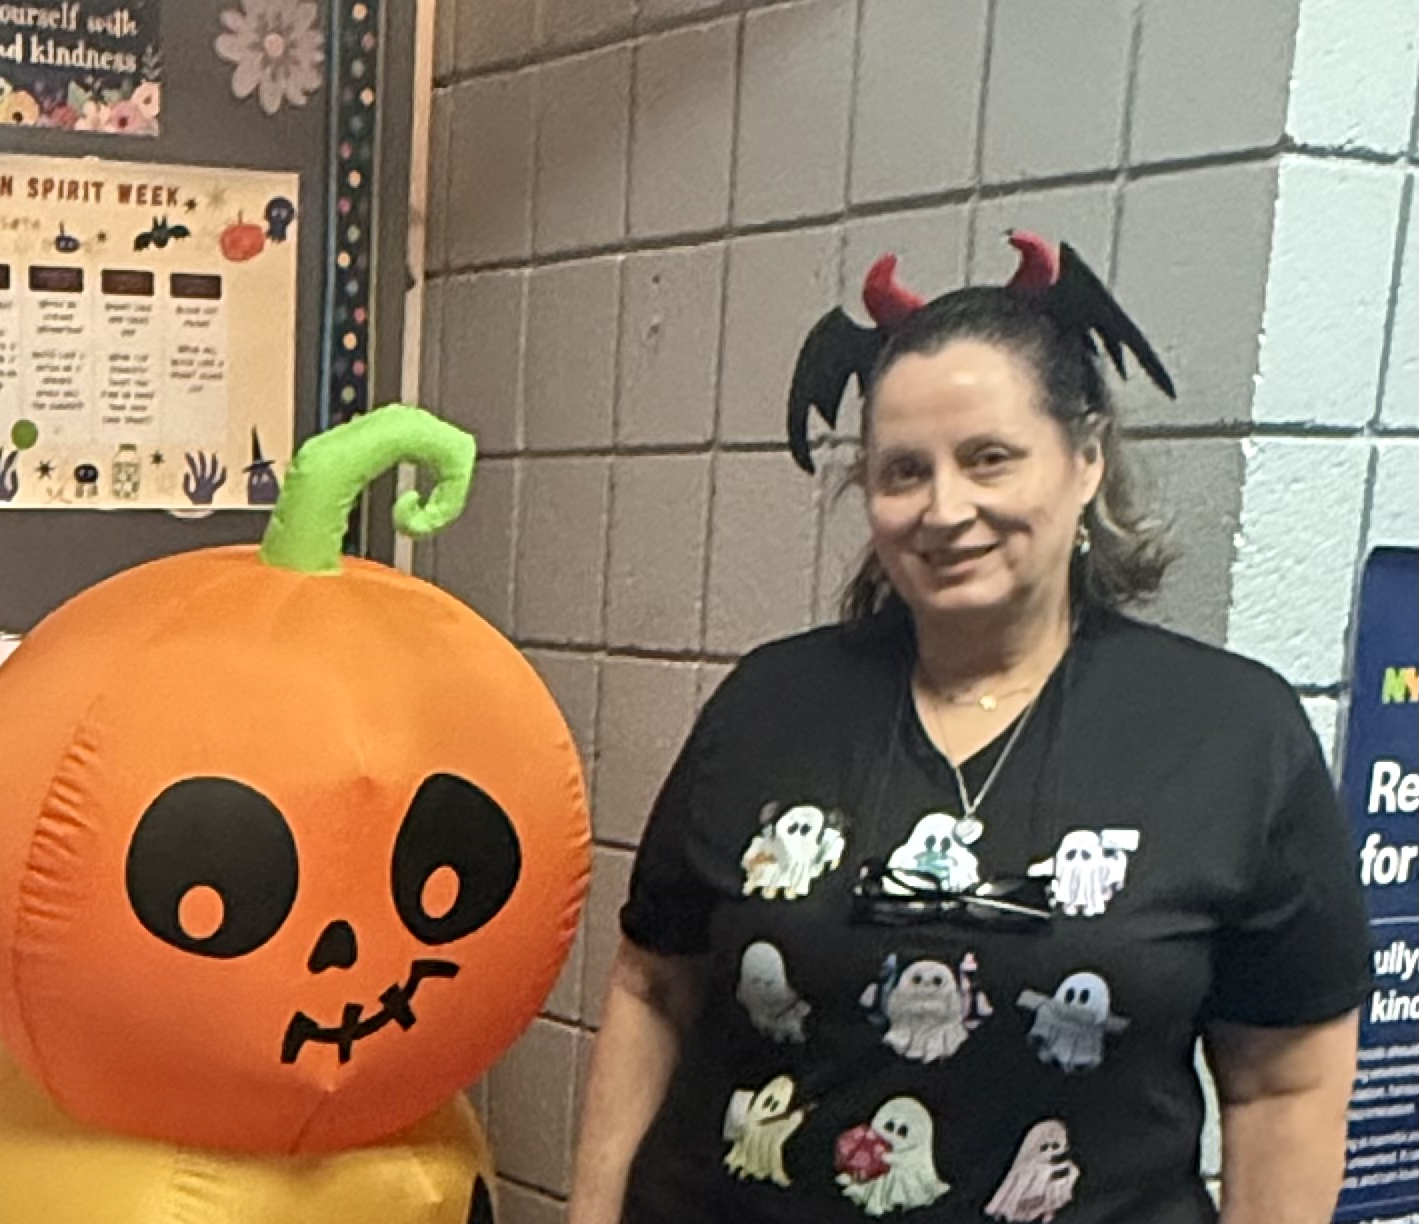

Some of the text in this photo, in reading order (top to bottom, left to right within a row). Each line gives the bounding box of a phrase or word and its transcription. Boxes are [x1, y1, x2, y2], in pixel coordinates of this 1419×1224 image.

[87, 8, 137, 38] with
[30, 33, 137, 73] kindness
[27, 176, 105, 204] SPIRIT
[117, 182, 180, 207] WEEK
[1359, 832, 1419, 886] for
[1372, 940, 1419, 982] ully
